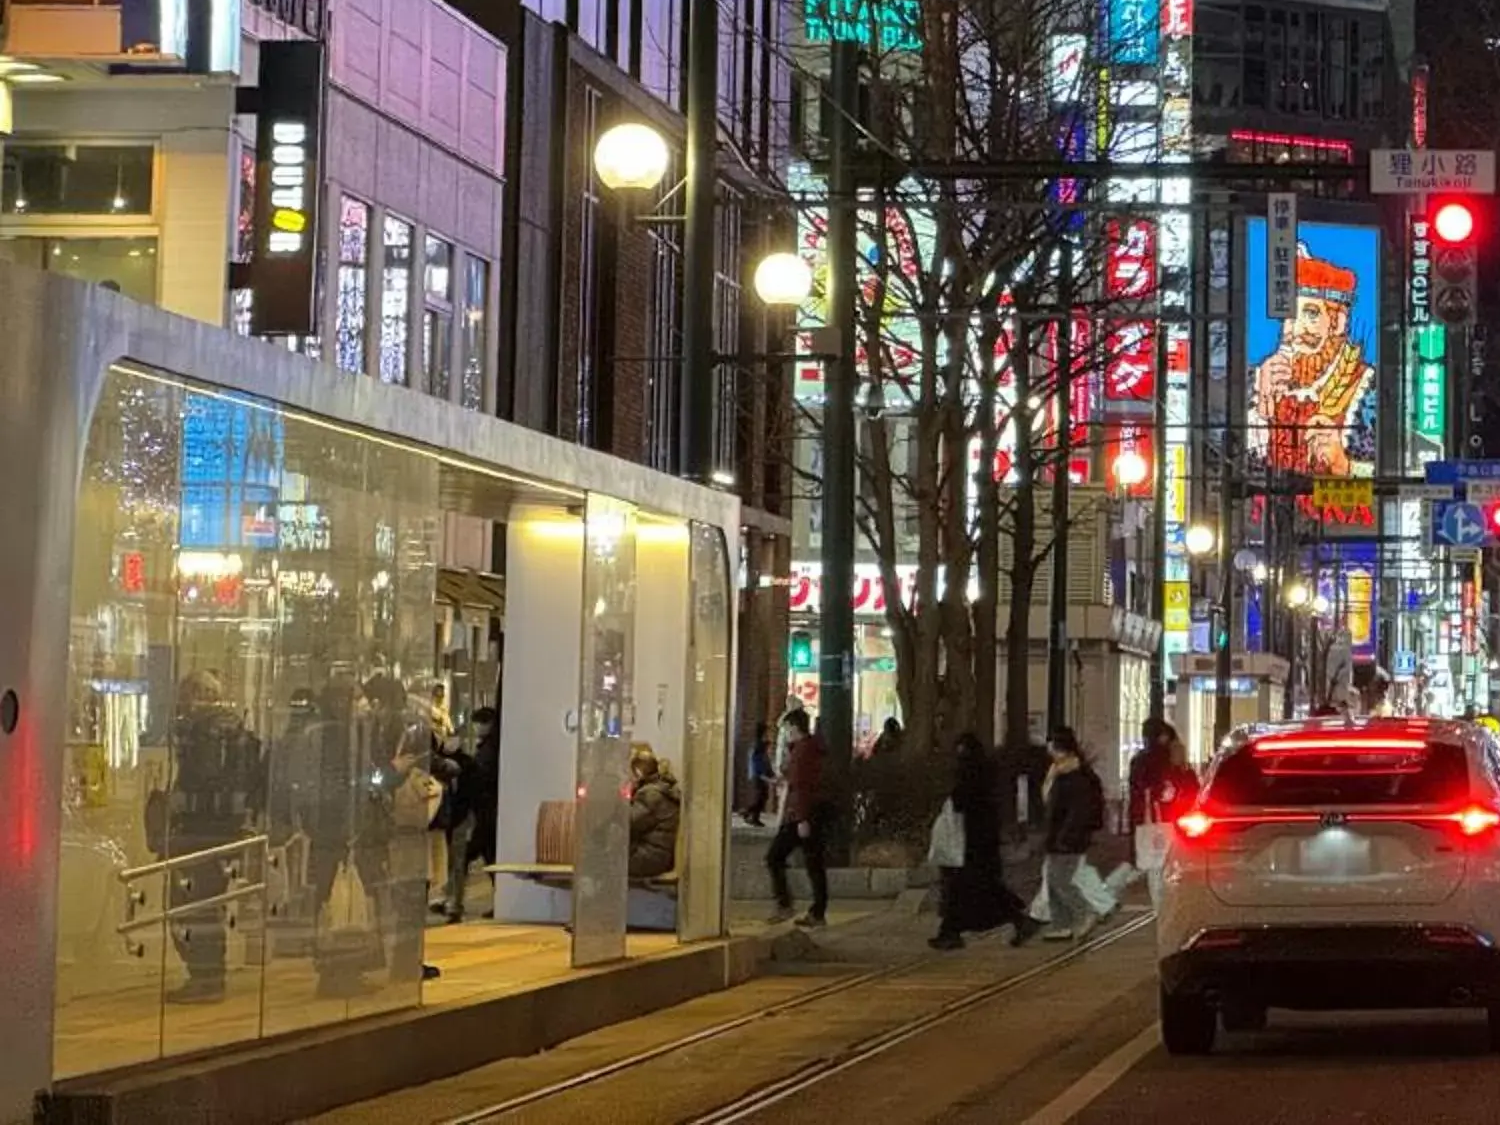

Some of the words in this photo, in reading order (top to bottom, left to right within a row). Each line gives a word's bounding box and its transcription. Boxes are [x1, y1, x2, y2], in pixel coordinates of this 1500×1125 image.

[269, 122, 307, 253] DOUTOR
[1388, 153, 1478, 175] 狸小路
